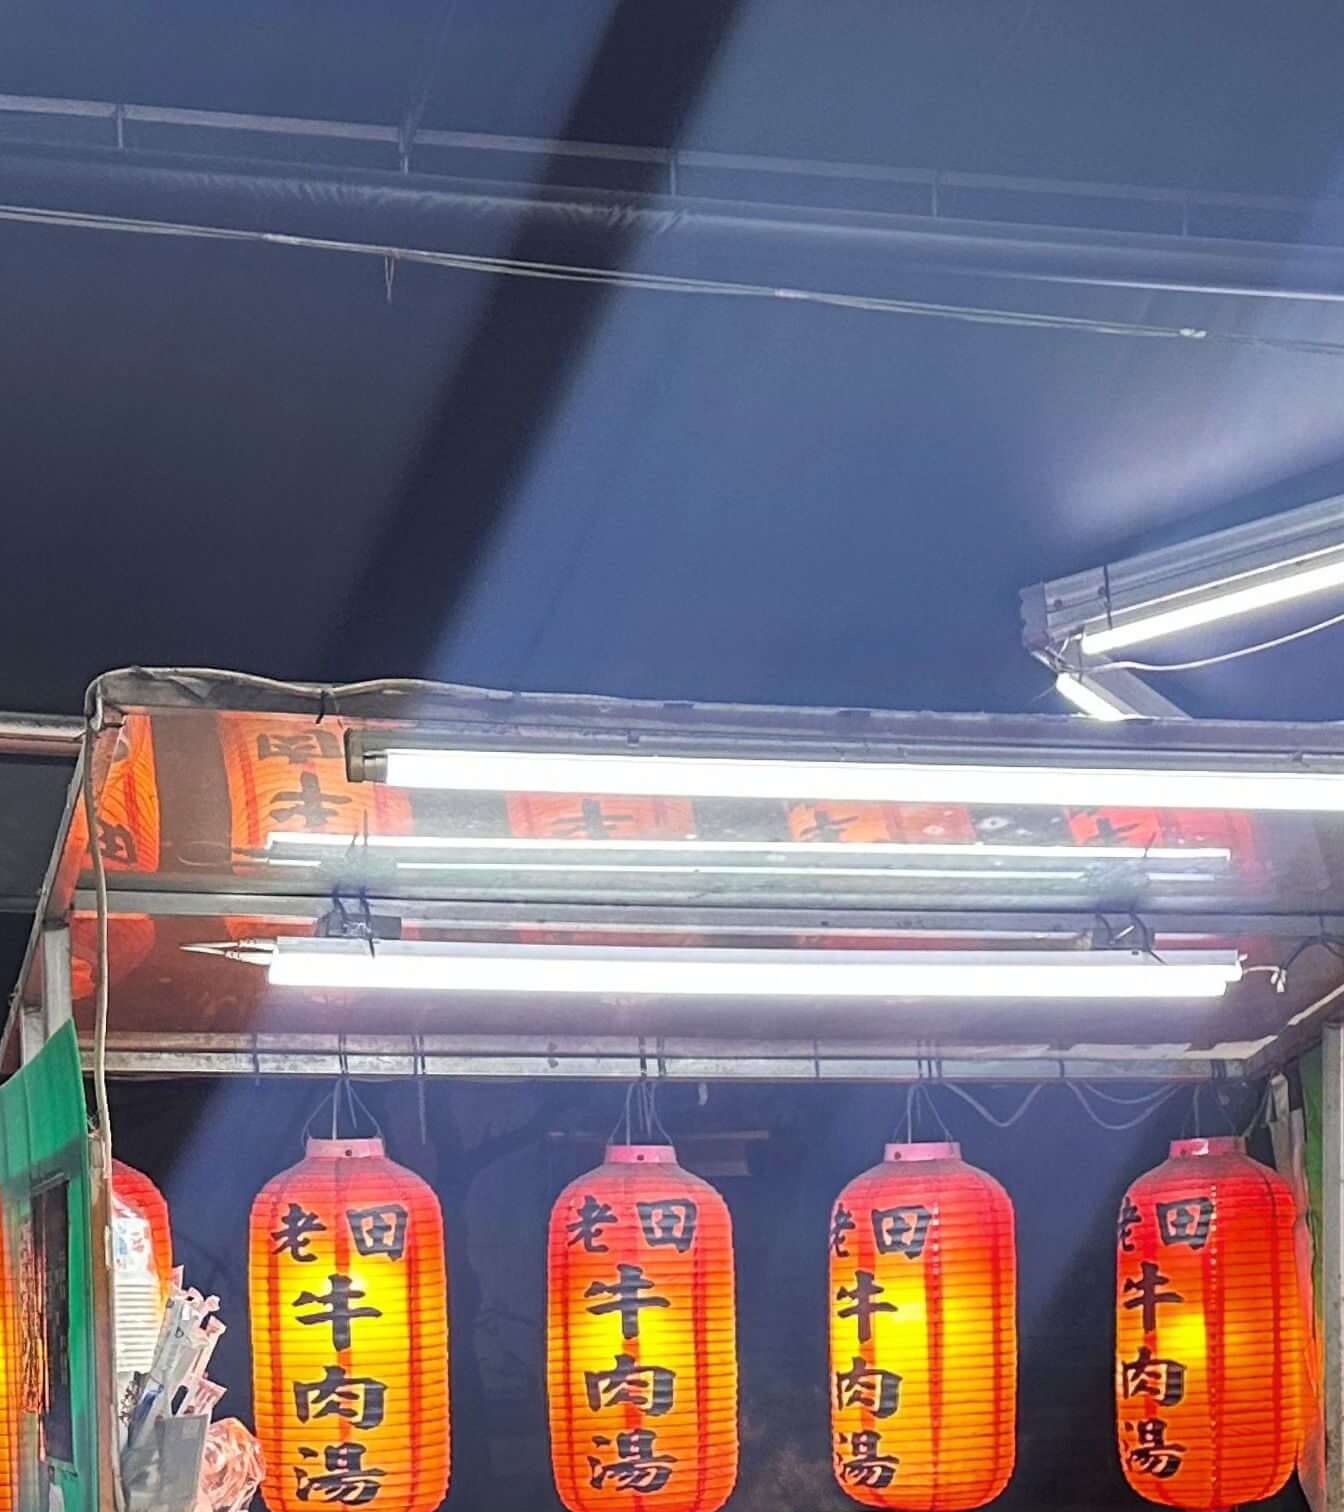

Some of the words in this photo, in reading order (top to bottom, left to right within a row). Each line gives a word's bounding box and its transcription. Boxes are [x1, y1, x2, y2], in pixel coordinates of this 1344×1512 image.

[291, 1273, 389, 1506] 牛肉湯
[584, 1263, 678, 1493] 牛肉湯
